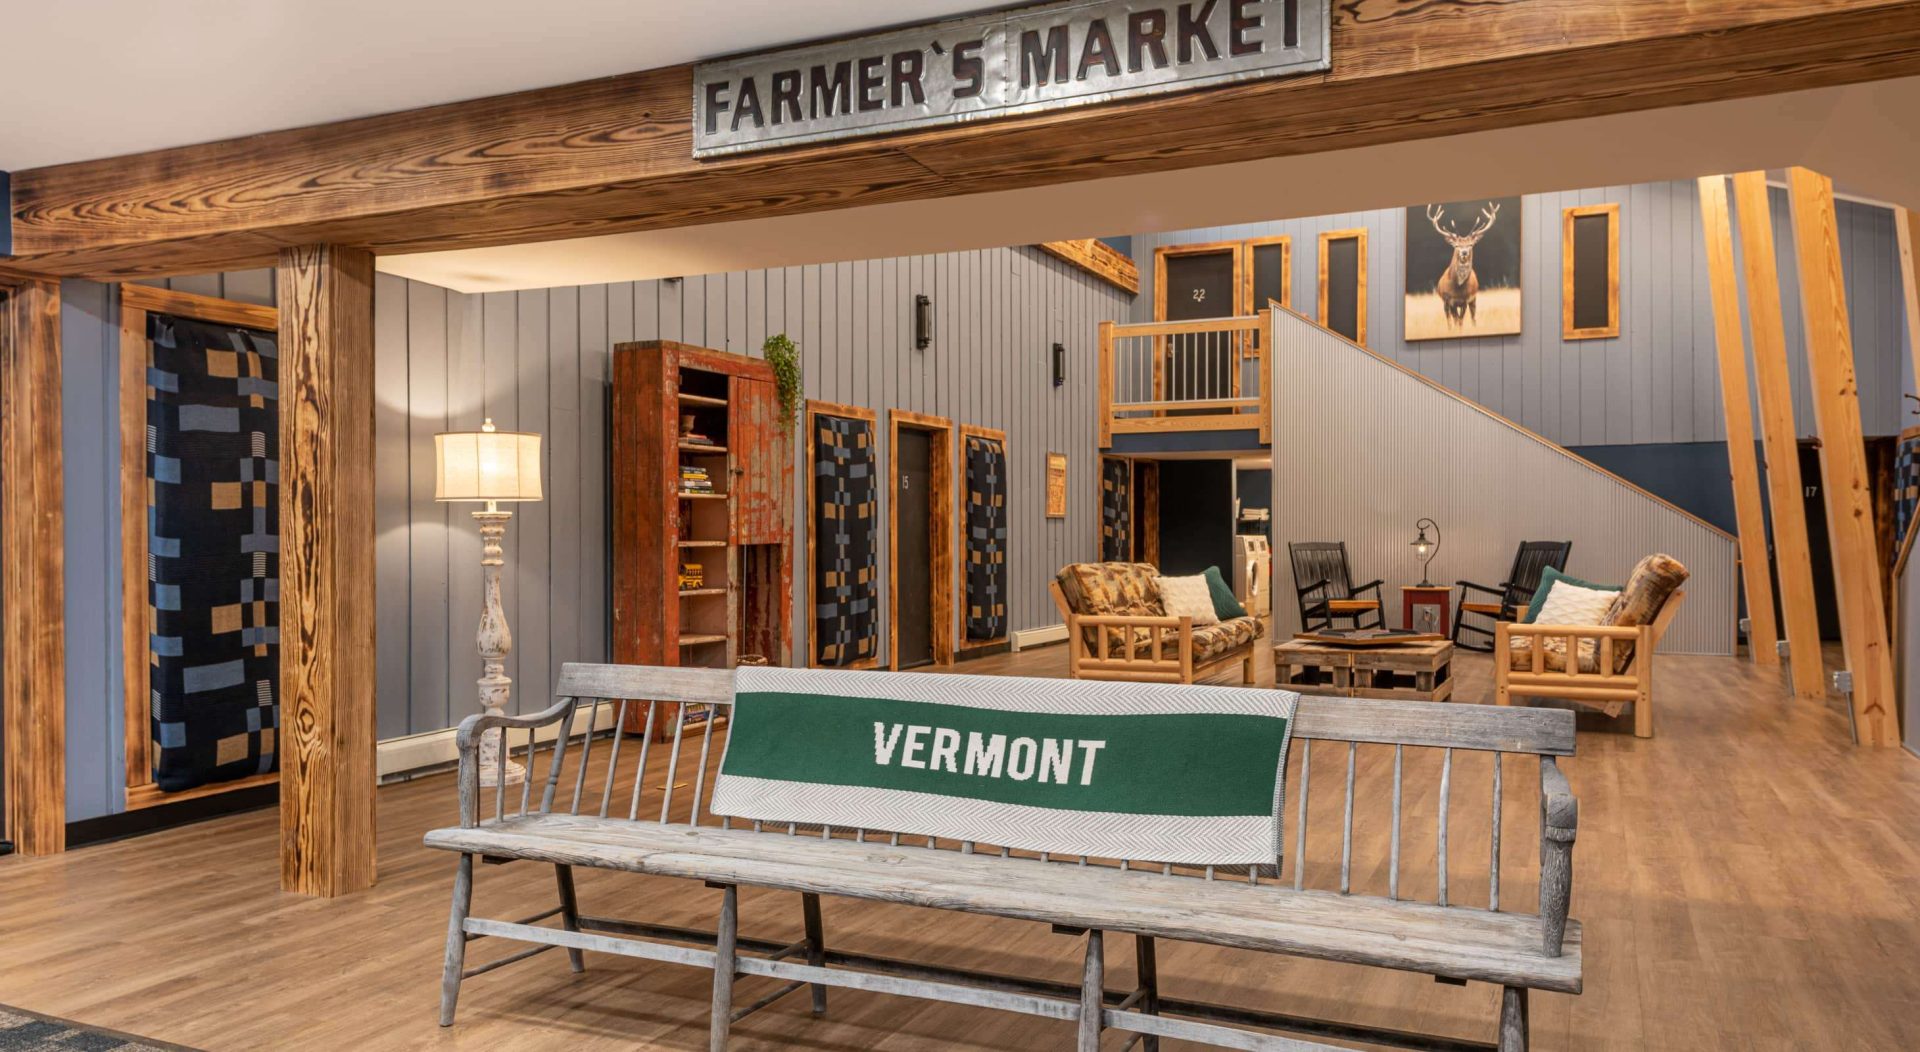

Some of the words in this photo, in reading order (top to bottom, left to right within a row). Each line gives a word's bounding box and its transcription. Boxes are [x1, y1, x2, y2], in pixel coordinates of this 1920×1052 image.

[1193, 288, 1205, 299] 22
[902, 475, 909, 489] 15
[1805, 486, 1817, 497] 17
[874, 721, 1106, 786] VERMONT
